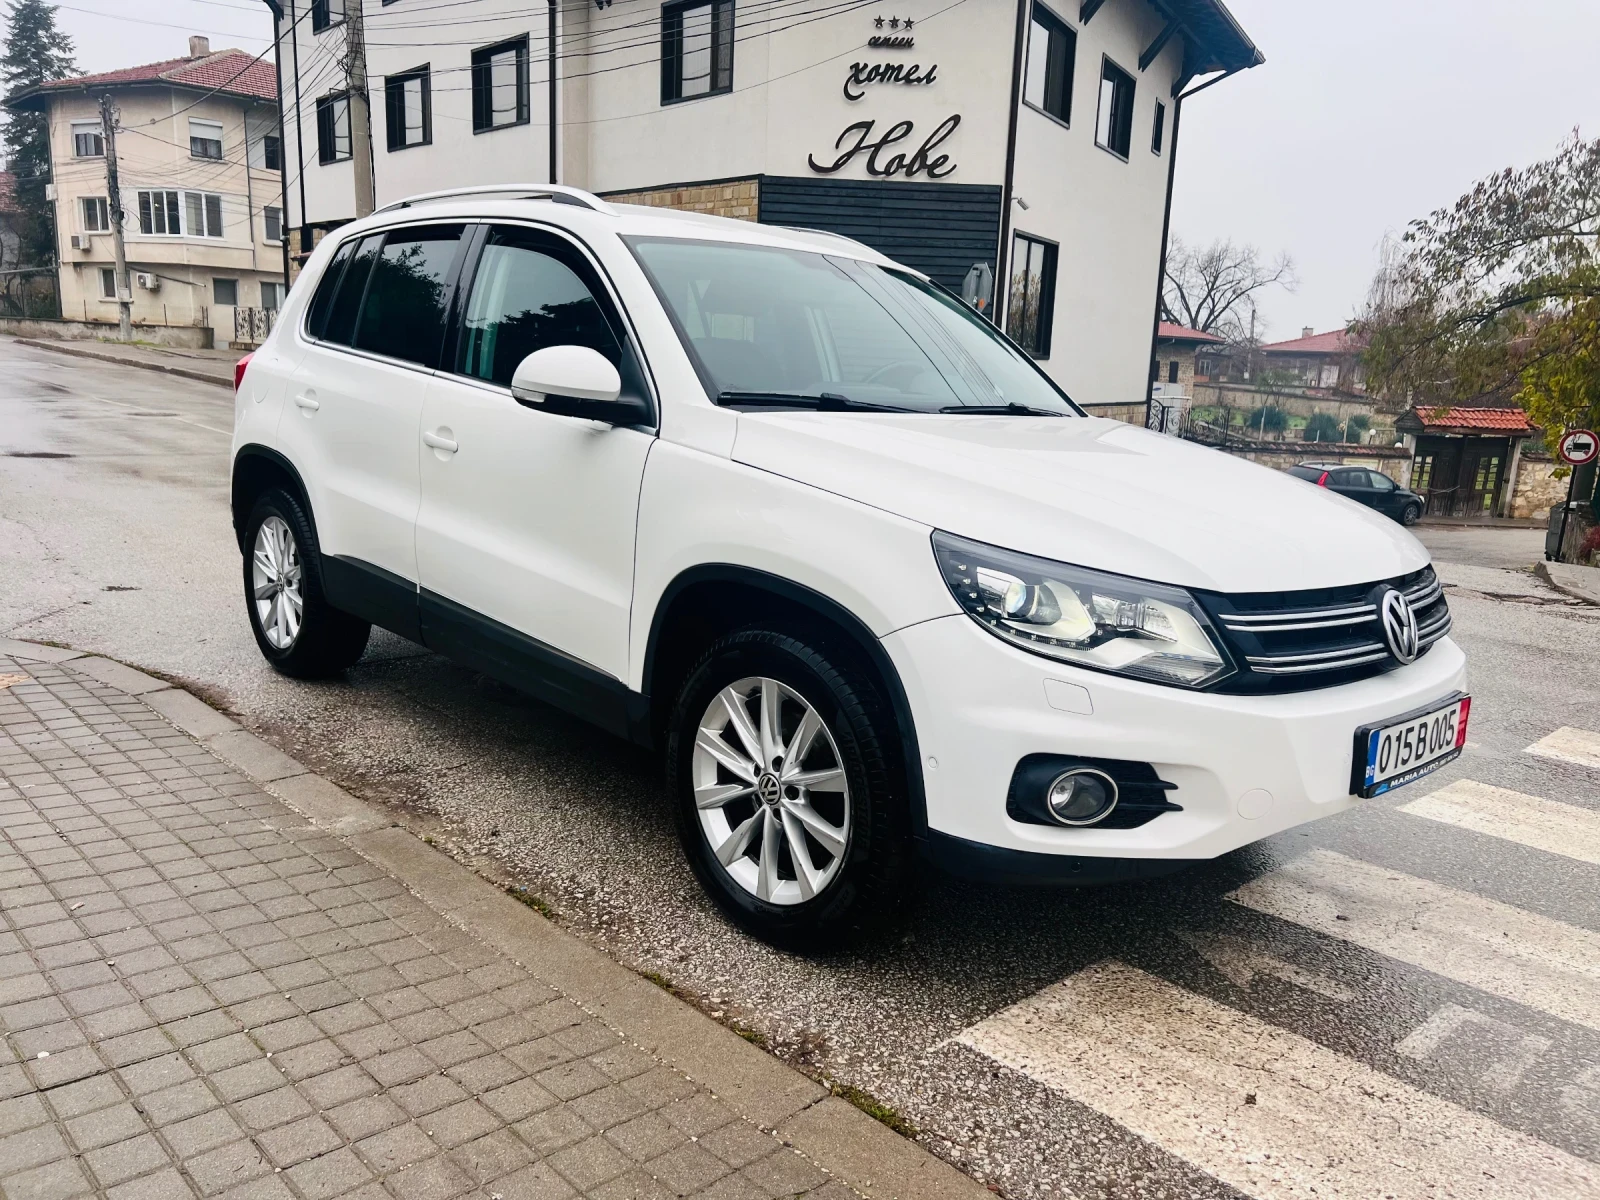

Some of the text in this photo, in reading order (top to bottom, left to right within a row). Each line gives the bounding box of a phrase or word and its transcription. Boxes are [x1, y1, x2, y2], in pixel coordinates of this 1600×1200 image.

[844, 63, 937, 101] хотел
[808, 114, 961, 179] Нове
[1379, 709, 1456, 774] 015B005
[1366, 765, 1375, 778] BG
[1390, 762, 1439, 788] MARIA AUTO
